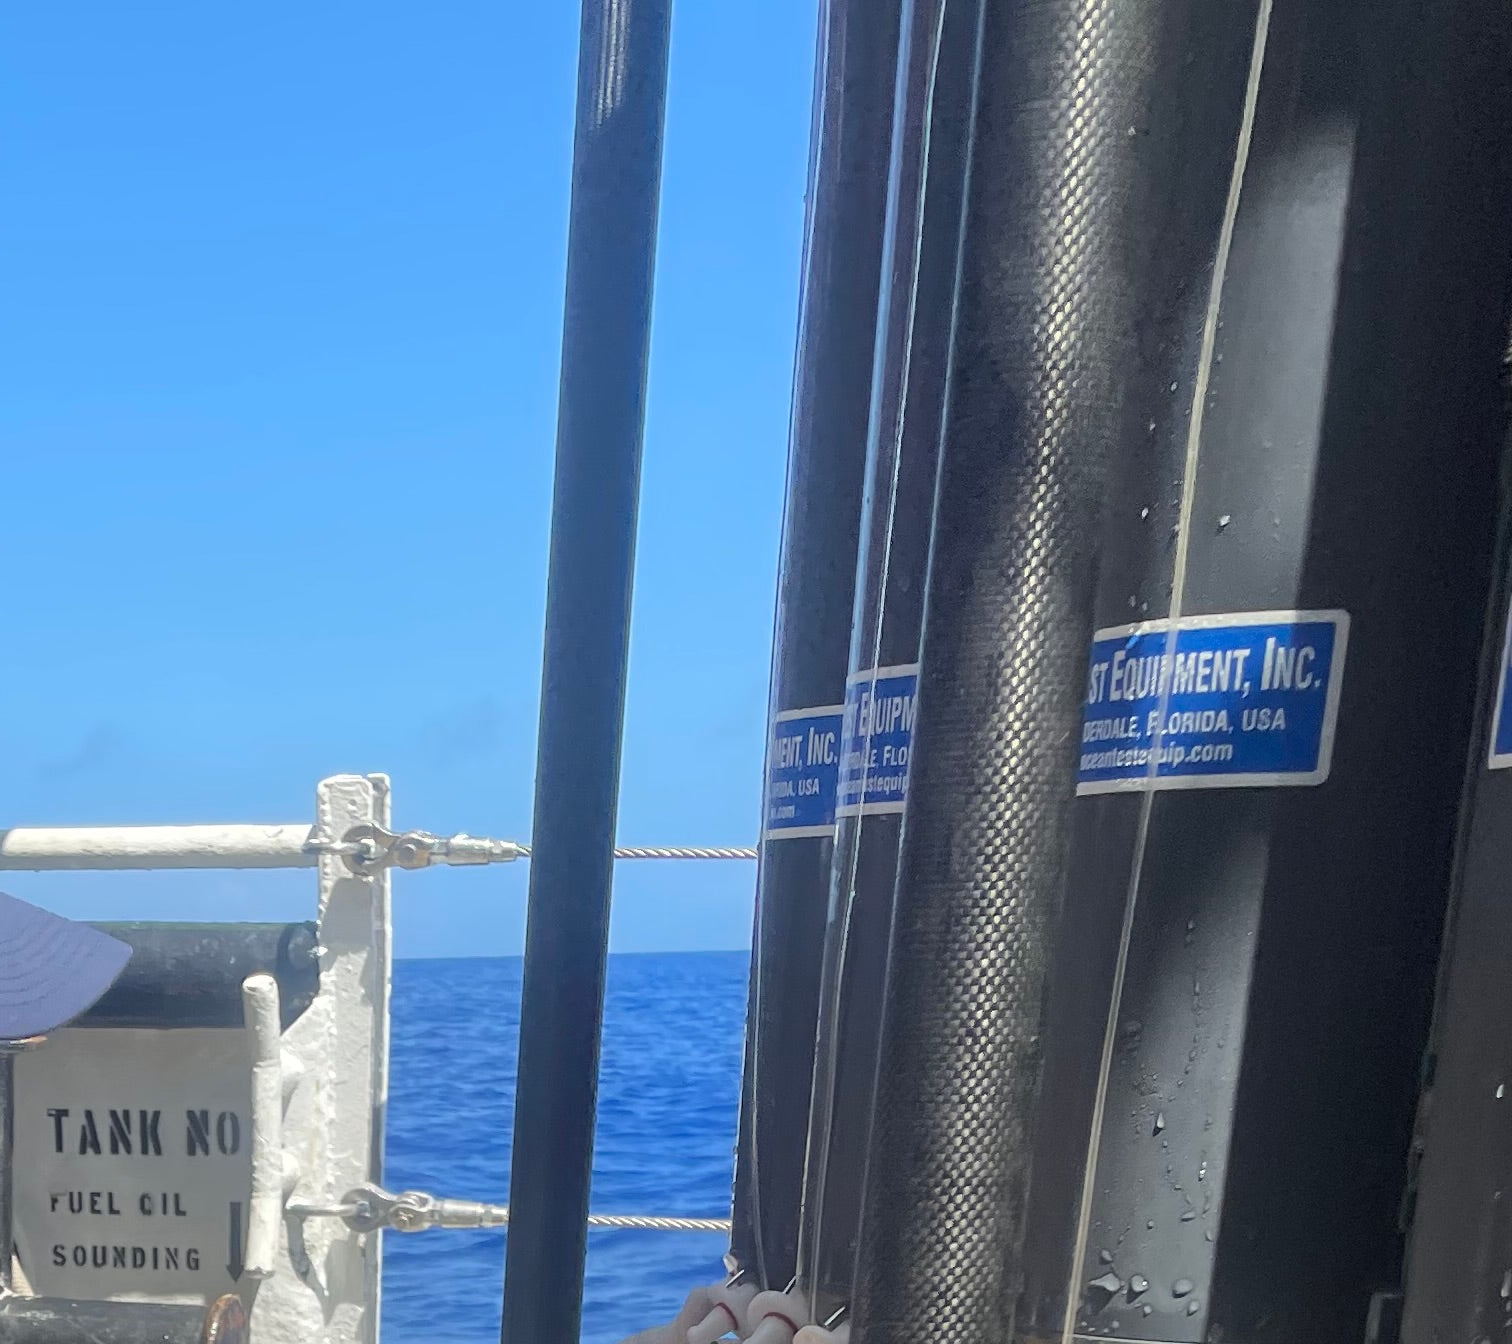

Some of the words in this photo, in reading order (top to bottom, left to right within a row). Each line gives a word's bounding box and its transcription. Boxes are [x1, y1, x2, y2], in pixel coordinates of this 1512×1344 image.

[1260, 636, 1322, 690] INC.
[1242, 707, 1286, 733] USA
[807, 727, 838, 766] INC.
[798, 778, 820, 796] USA
[47, 1108, 163, 1156] TANK
[186, 1108, 241, 1157] NO
[49, 1190, 121, 1216] FUEL
[52, 1243, 201, 1271] SOUNDING
